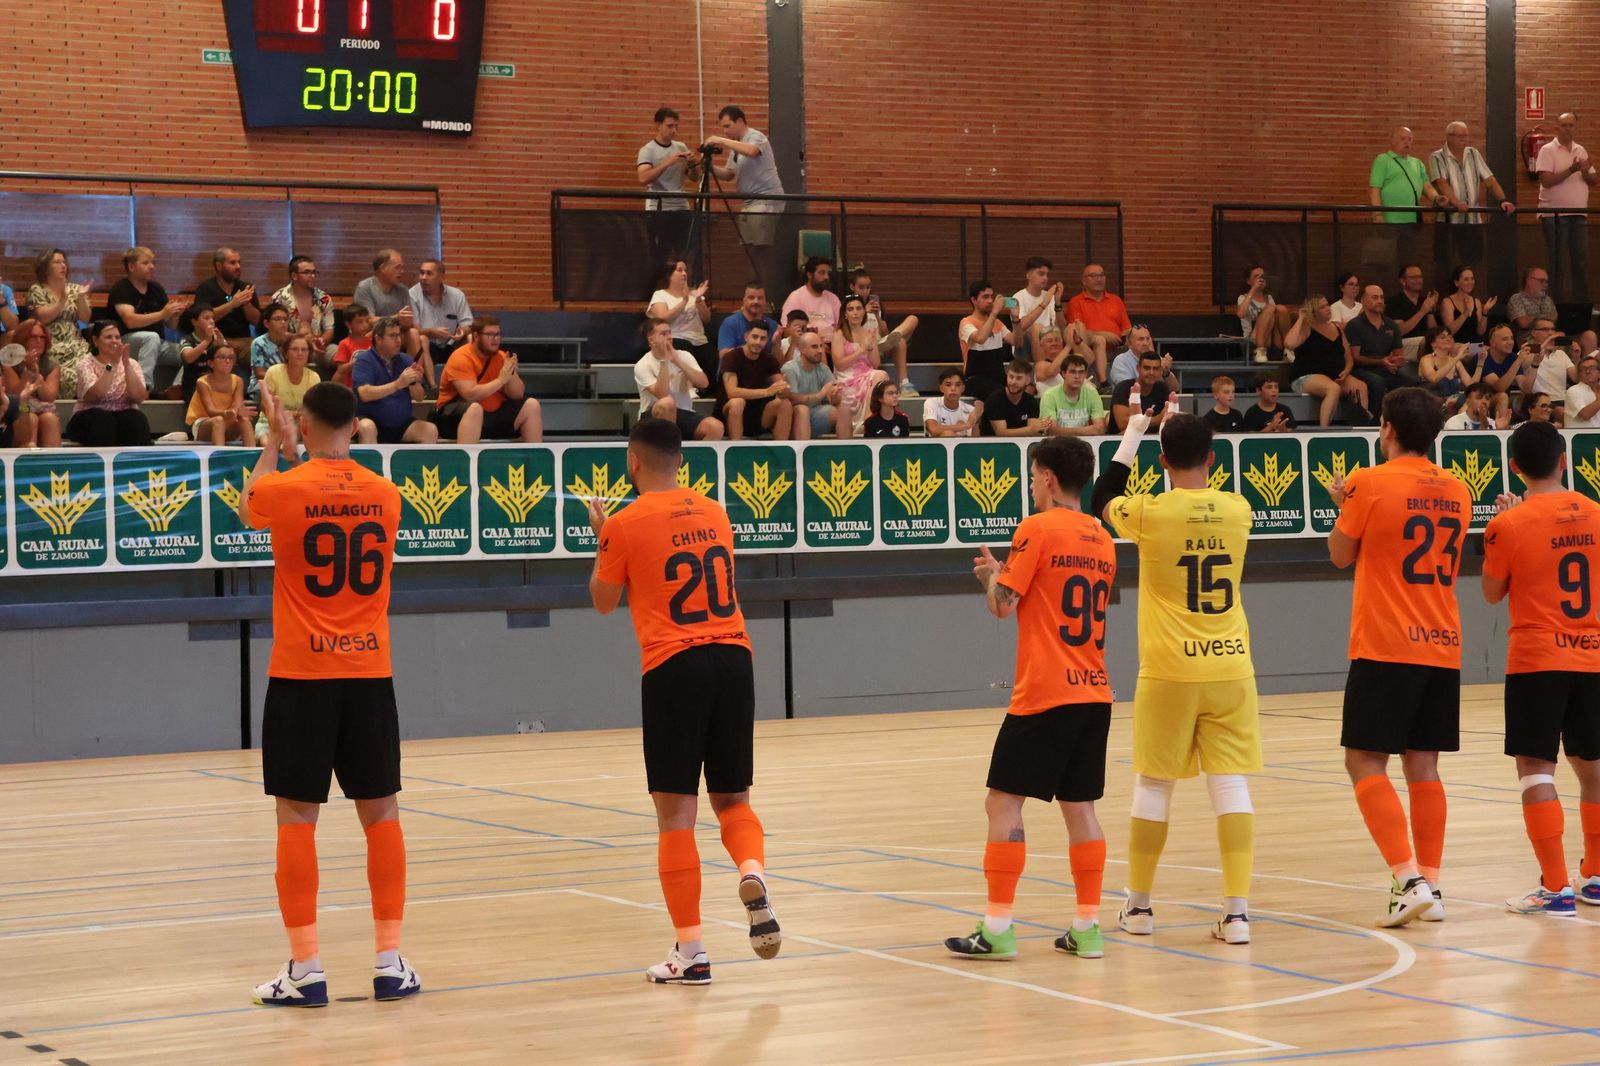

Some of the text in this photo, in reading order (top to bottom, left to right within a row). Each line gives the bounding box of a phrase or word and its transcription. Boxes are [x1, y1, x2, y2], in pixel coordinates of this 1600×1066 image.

[433, 0, 456, 40] 0
[340, 38, 381, 50] PERIODO
[303, 67, 417, 113] 20:00
[430, 120, 472, 132] MONDO
[305, 504, 383, 518] MALAGUTI
[1406, 496, 1461, 514] ERIC PÉREZ
[1251, 509, 1302, 520] AJA RURAL
[1313, 508, 1337, 519] CAJA
[731, 522, 795, 534] CAJA RURAL
[807, 520, 871, 532] CAJA RURAL
[883, 518, 947, 530] CAJA RURAL
[958, 516, 1020, 528] CAJA RURAL
[1265, 519, 1293, 527] ZAMORA
[396, 527, 468, 541] CAJA RURAL
[482, 526, 553, 539] CAJA RURAL
[566, 526, 595, 537] CAJA
[671, 528, 717, 547] CHINO
[740, 533, 784, 542] DE ZAMORA
[831, 531, 861, 539] ZAMORA
[907, 529, 936, 537] ZAMORA
[20, 538, 104, 552] CAJA RURAL
[119, 535, 200, 549] CAJA RURAL
[214, 533, 248, 546] CAJA
[408, 539, 456, 549] DE ZAMORA
[494, 538, 541, 547] DE ZAMORA
[1185, 536, 1226, 551] RAÚL
[1551, 533, 1596, 549] SAMUEL
[35, 551, 90, 561] DE ZAMORA
[133, 548, 186, 557] DE ZAMORA
[242, 545, 273, 553] ZAMOR
[1402, 514, 1462, 587] 23
[303, 521, 387, 598] 96
[1051, 555, 1095, 571] FABINHO
[664, 545, 736, 625] 20
[1176, 553, 1234, 615] 15
[1558, 551, 1591, 619] 9
[1059, 574, 1109, 651] 99
[309, 632, 380, 653] uvesa
[1408, 625, 1460, 647] uvesa
[1184, 638, 1245, 657] uvesa
[1066, 668, 1107, 686] uves
